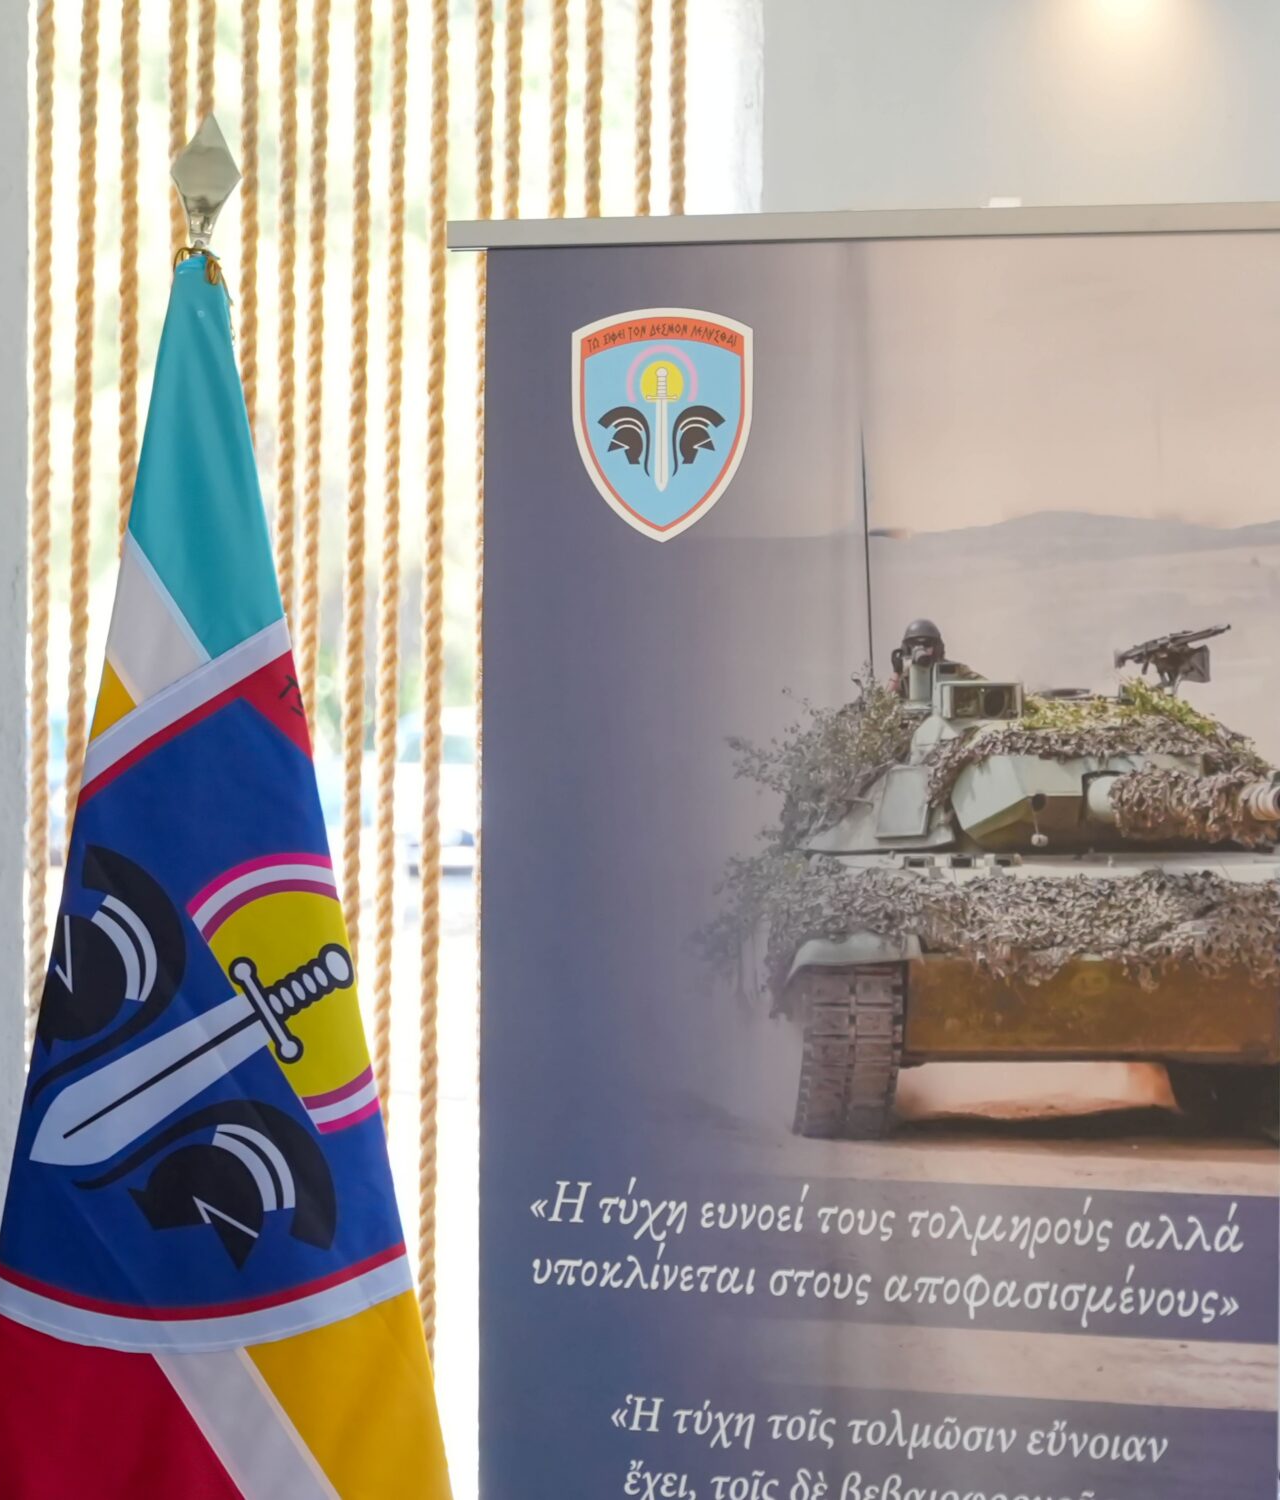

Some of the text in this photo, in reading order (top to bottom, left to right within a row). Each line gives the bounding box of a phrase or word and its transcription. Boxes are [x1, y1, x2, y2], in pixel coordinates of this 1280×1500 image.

[530, 1177, 1244, 1259] «Η τύχη ευνοεί τους τολμηρούς αλλά
[532, 1243, 1240, 1327] υποκλίνεται στους αποφασισμένους»
[673, 1399, 755, 1450] τύχη
[767, 1409, 837, 1450] τοῖς
[847, 1409, 1017, 1460] τολμῶσιν
[1027, 1420, 1169, 1464] εὔνοιαν
